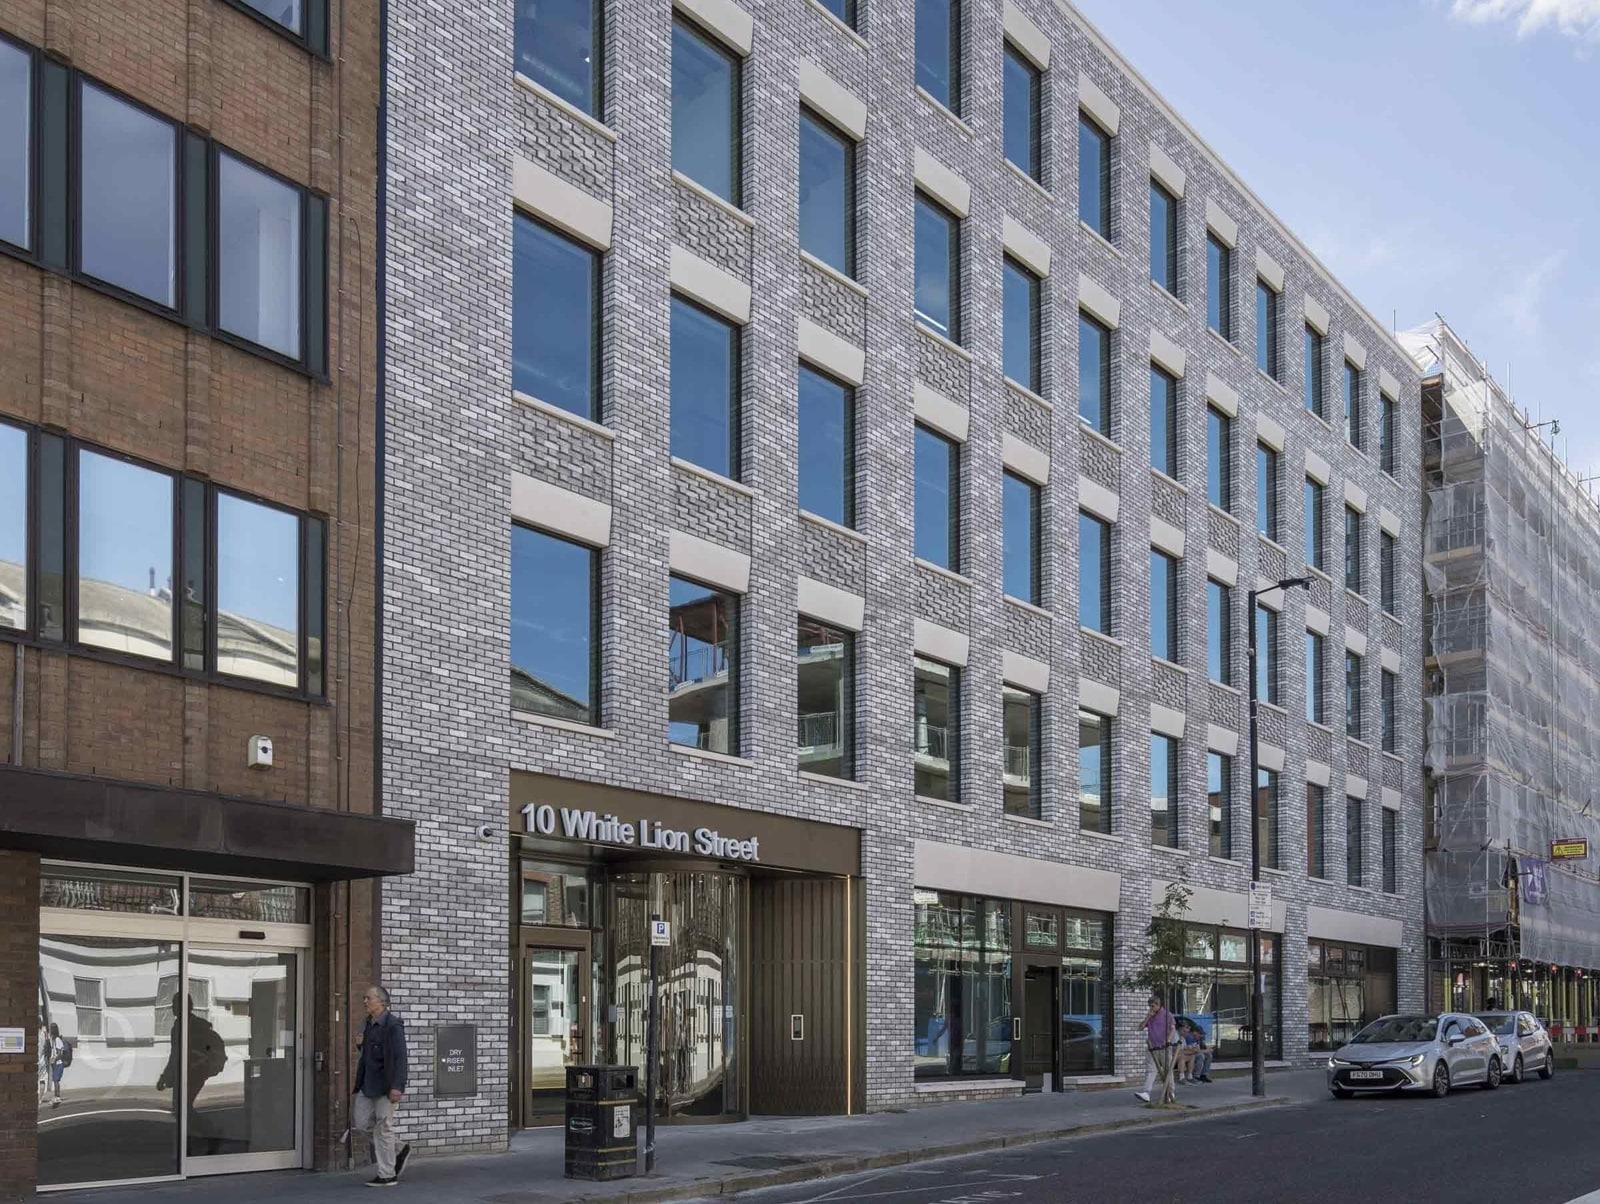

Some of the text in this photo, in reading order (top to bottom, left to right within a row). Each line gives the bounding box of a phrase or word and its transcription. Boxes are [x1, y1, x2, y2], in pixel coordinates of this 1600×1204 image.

[521, 803, 760, 861] 10 White Lion Street
